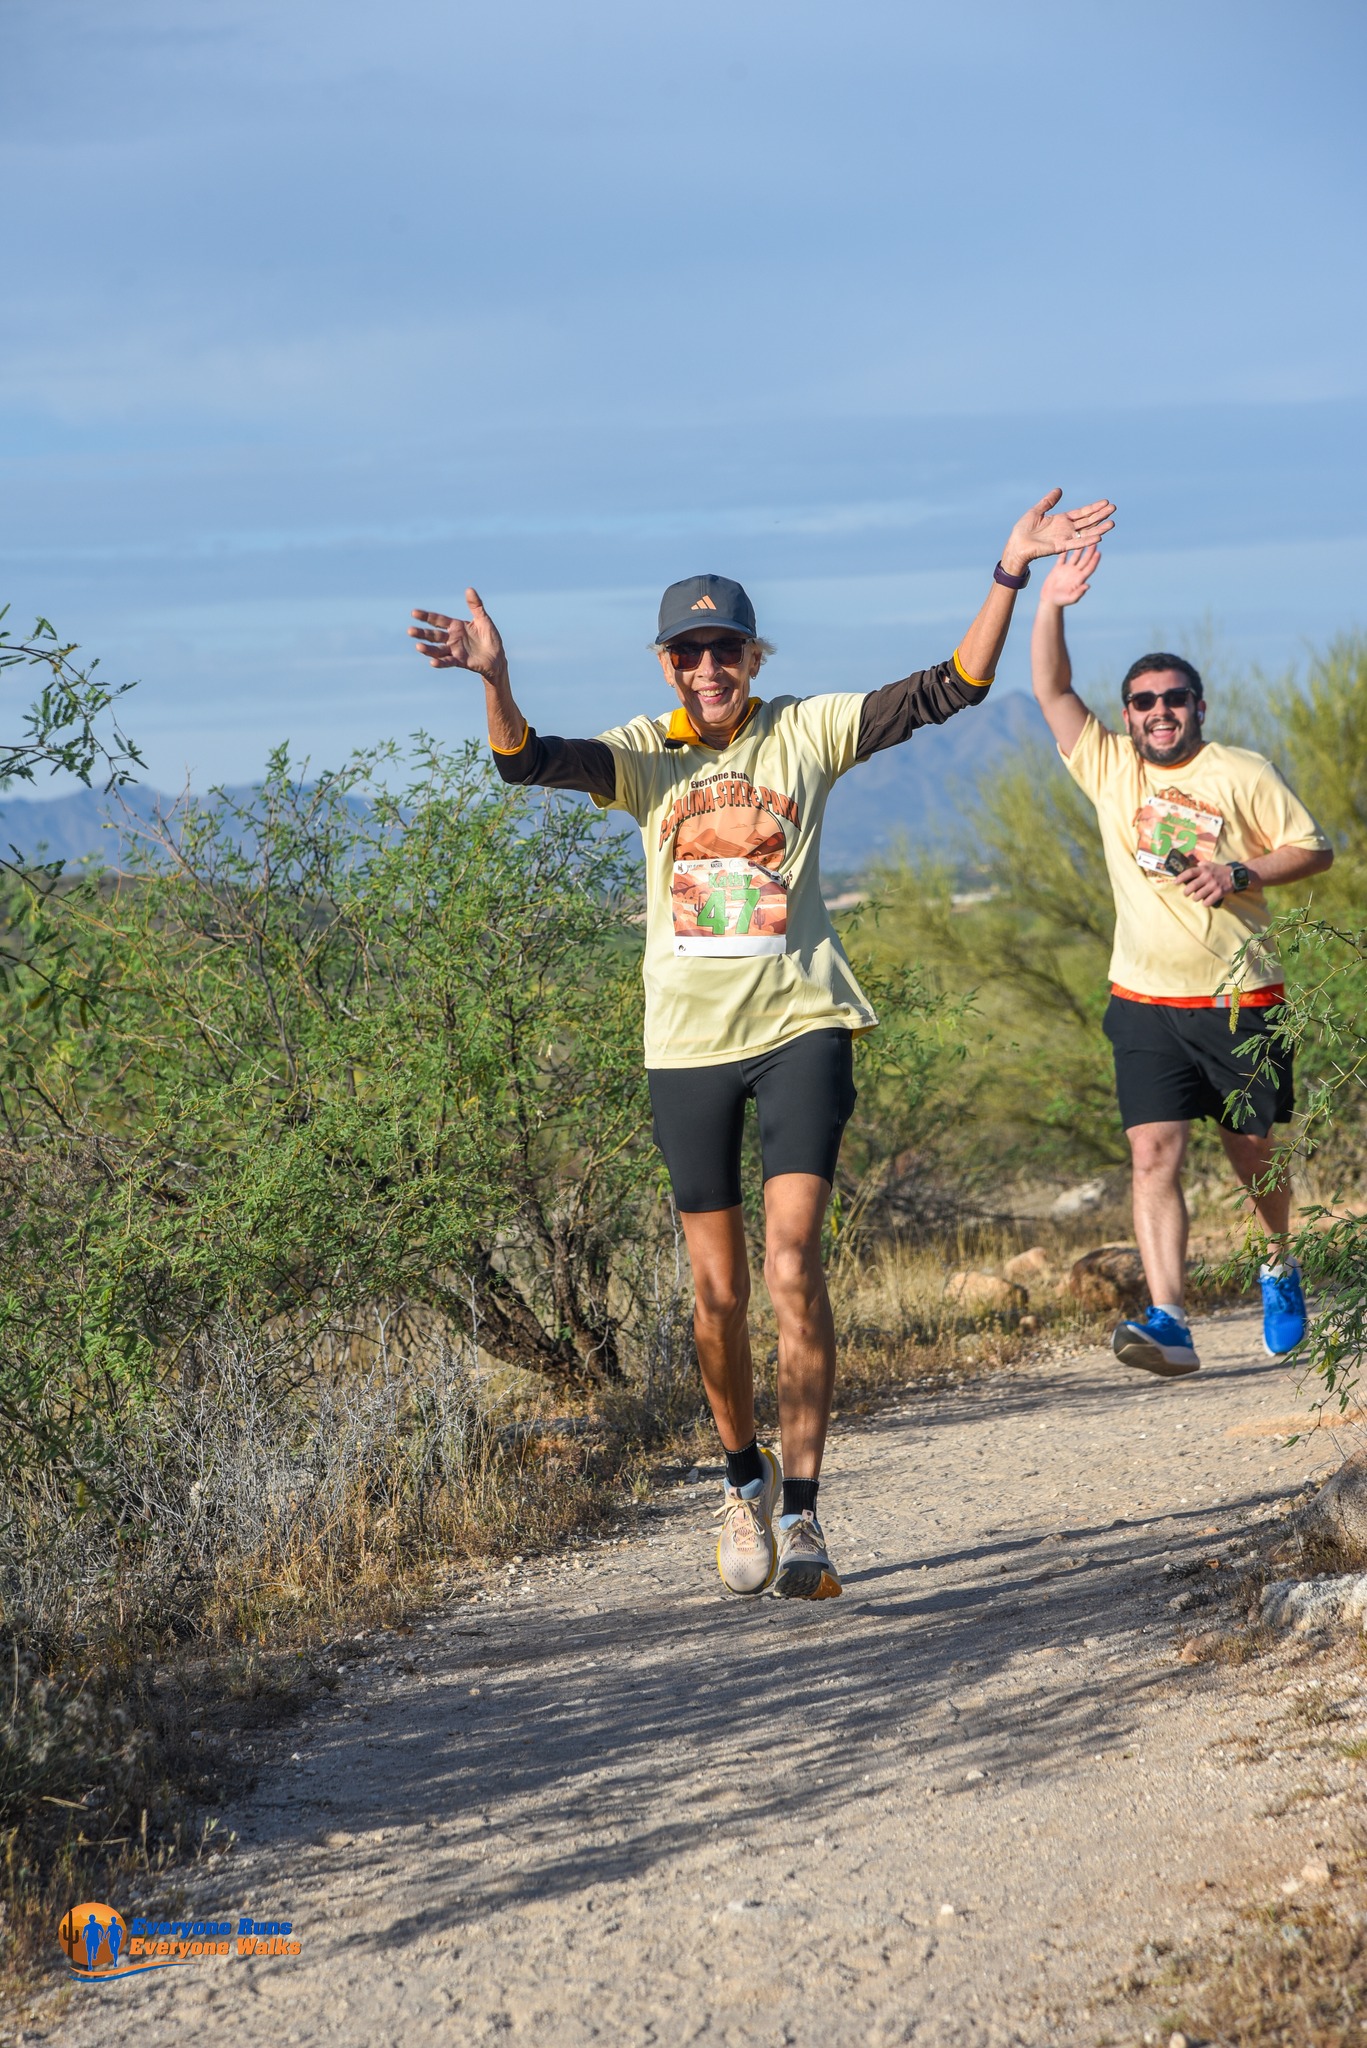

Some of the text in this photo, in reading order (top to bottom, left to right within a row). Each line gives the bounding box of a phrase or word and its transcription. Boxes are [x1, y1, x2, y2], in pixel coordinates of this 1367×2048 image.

[691, 771, 751, 788] Everyone Run
[716, 780, 762, 810] STATE
[758, 786, 801, 832] PARK
[1151, 821, 1198, 857] 52
[708, 872, 753, 890] Kathy
[697, 888, 761, 935] 47
